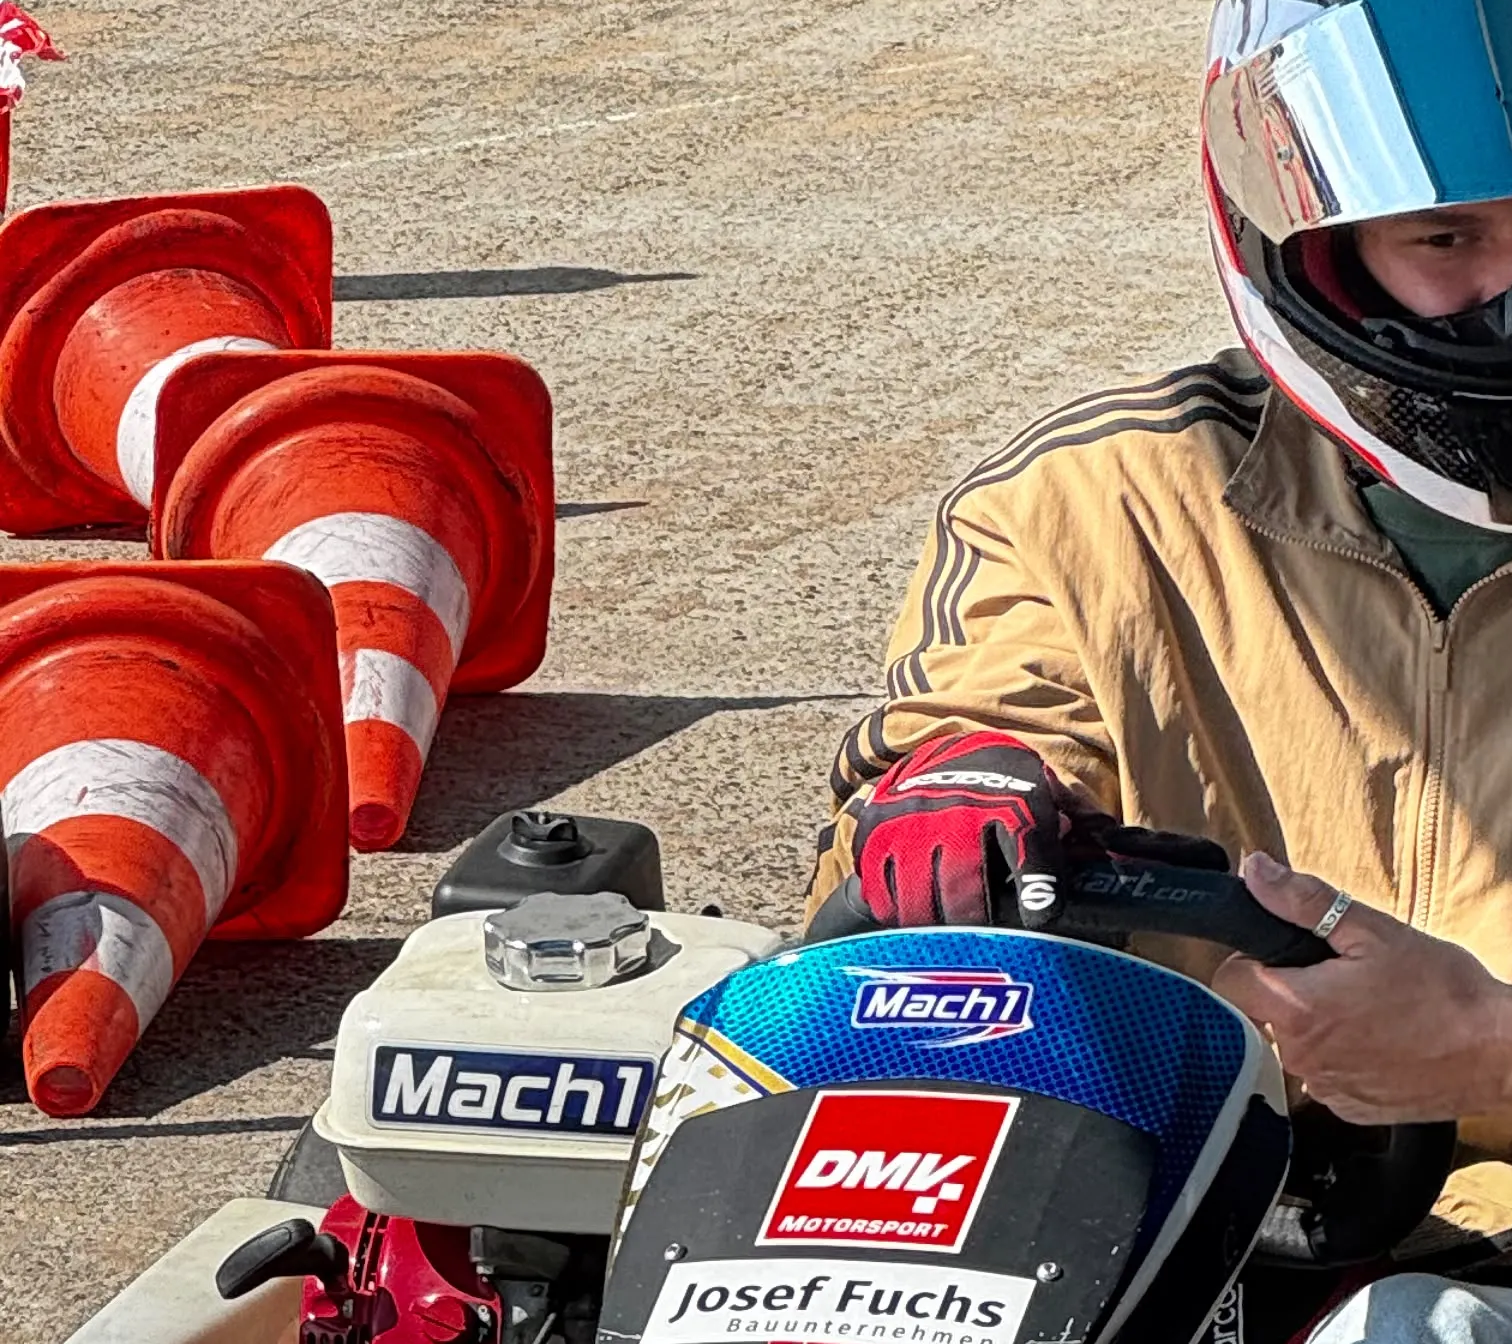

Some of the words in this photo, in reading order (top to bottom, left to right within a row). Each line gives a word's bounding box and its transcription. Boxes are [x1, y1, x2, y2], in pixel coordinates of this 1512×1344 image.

[863, 986, 1022, 1022] Mach1
[381, 1052, 643, 1128] Mach1
[795, 1150, 977, 1191] DMV
[777, 1215, 949, 1238] MOTORSPORT
[668, 1276, 831, 1324] Josef
[835, 1279, 1006, 1328] Fuchs
